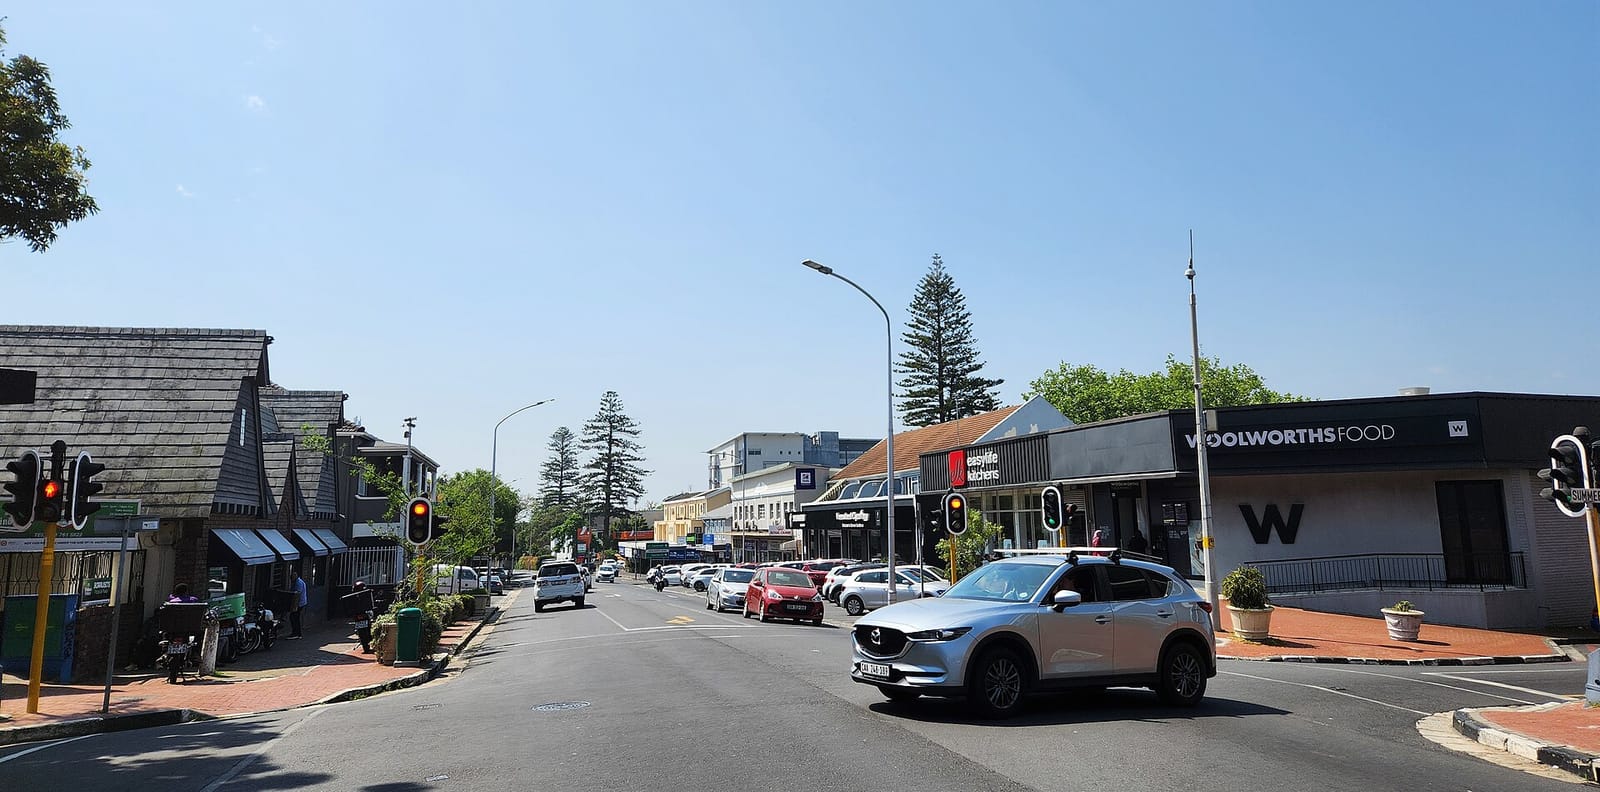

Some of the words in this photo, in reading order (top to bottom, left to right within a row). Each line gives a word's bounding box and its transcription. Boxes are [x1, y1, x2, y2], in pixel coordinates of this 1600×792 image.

[966, 451, 998, 468] easylife
[967, 469, 1000, 482] kitchens
[1572, 490, 1600, 501] SUMME
[1239, 503, 1305, 545] W
